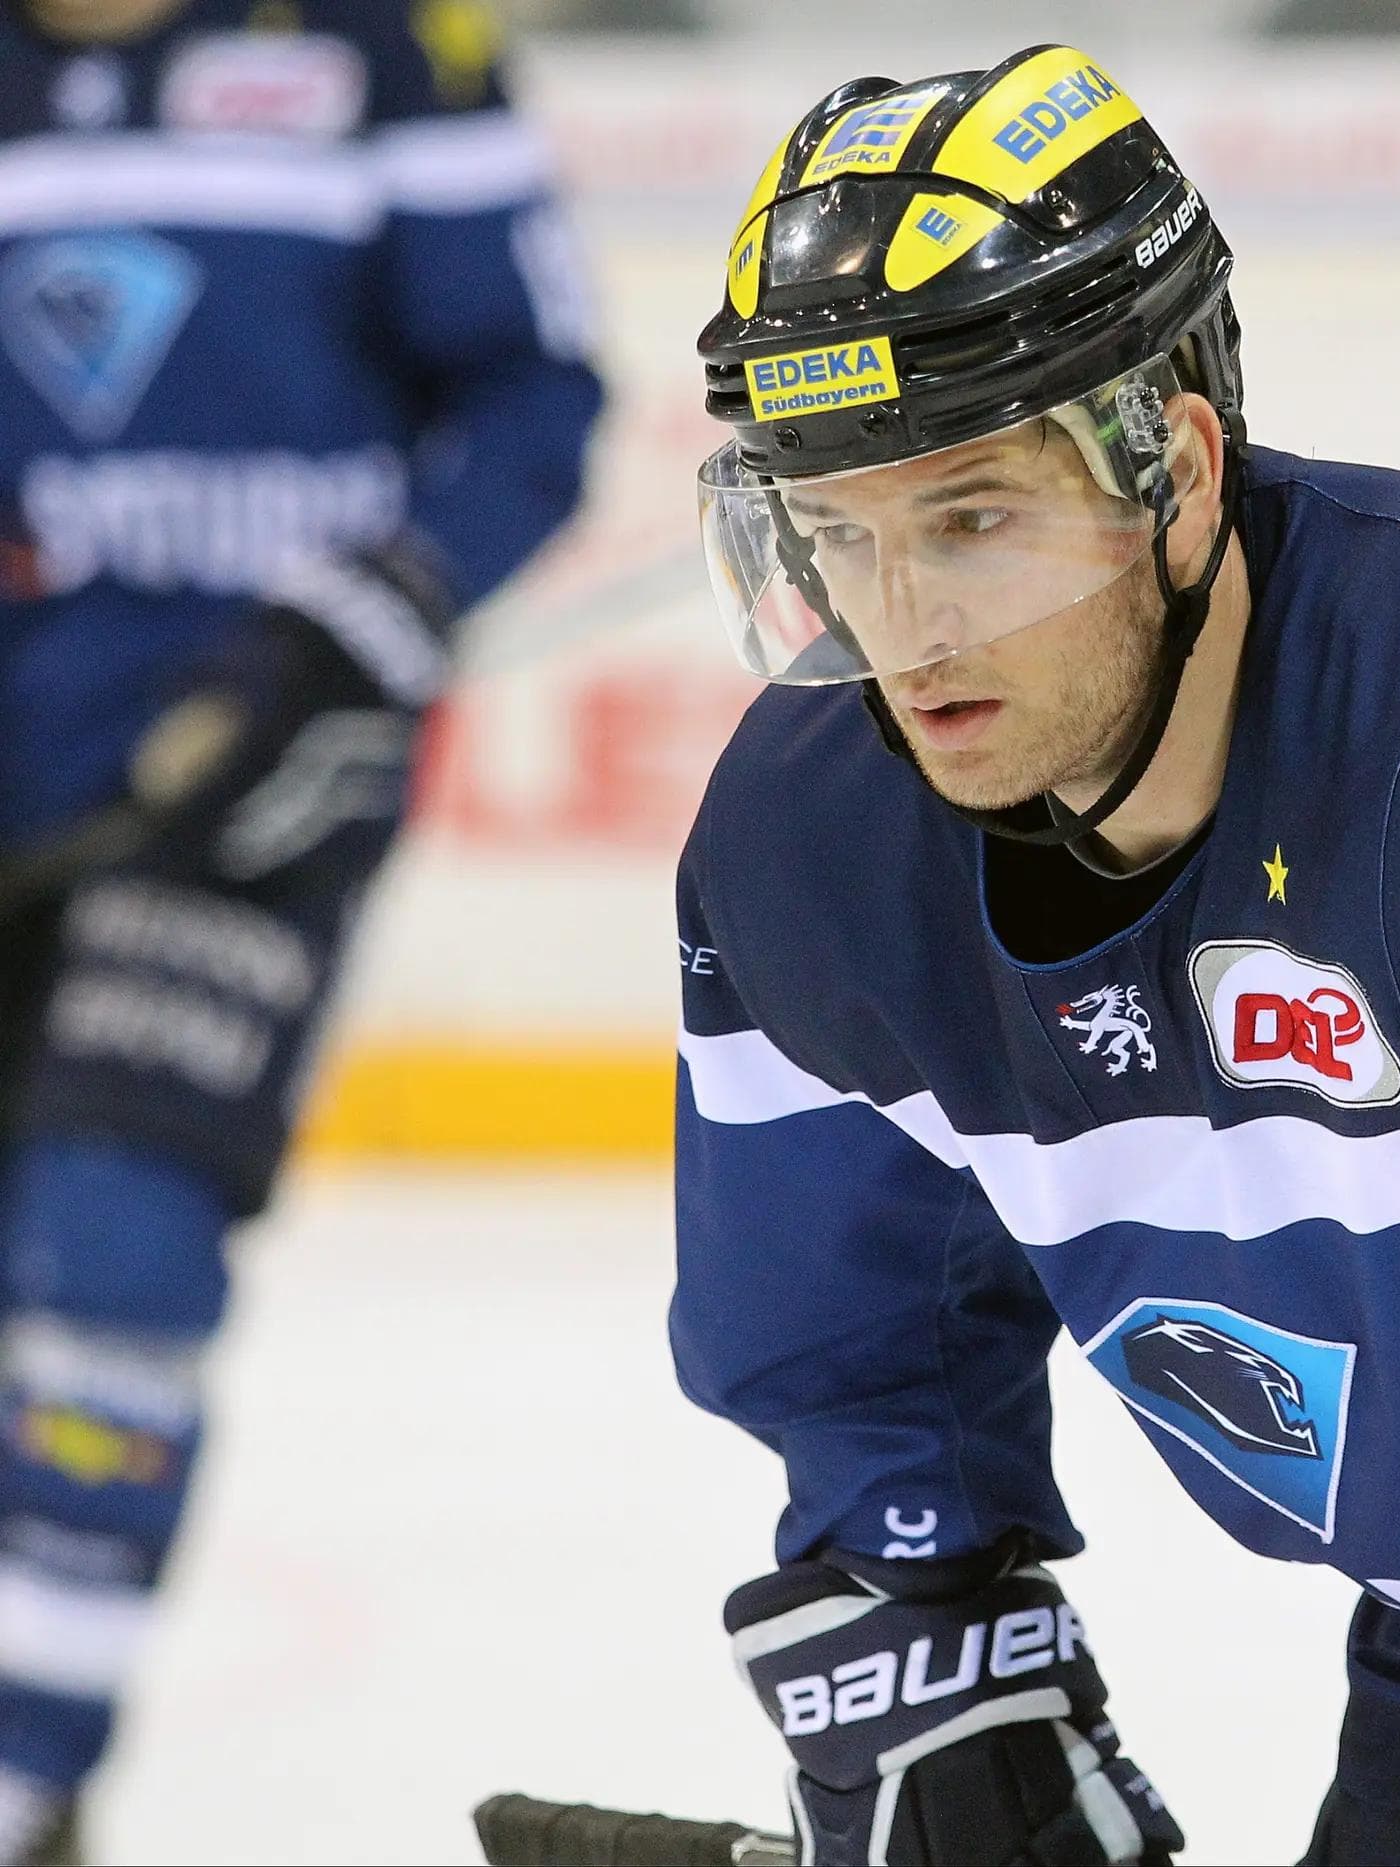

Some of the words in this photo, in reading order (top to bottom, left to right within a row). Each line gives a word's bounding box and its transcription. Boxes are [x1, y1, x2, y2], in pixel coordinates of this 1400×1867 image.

[992, 64, 1121, 164] EDEKA
[813, 151, 891, 175] EDEKA
[753, 345, 882, 392] EDEKA
[761, 382, 886, 414] Südbayern
